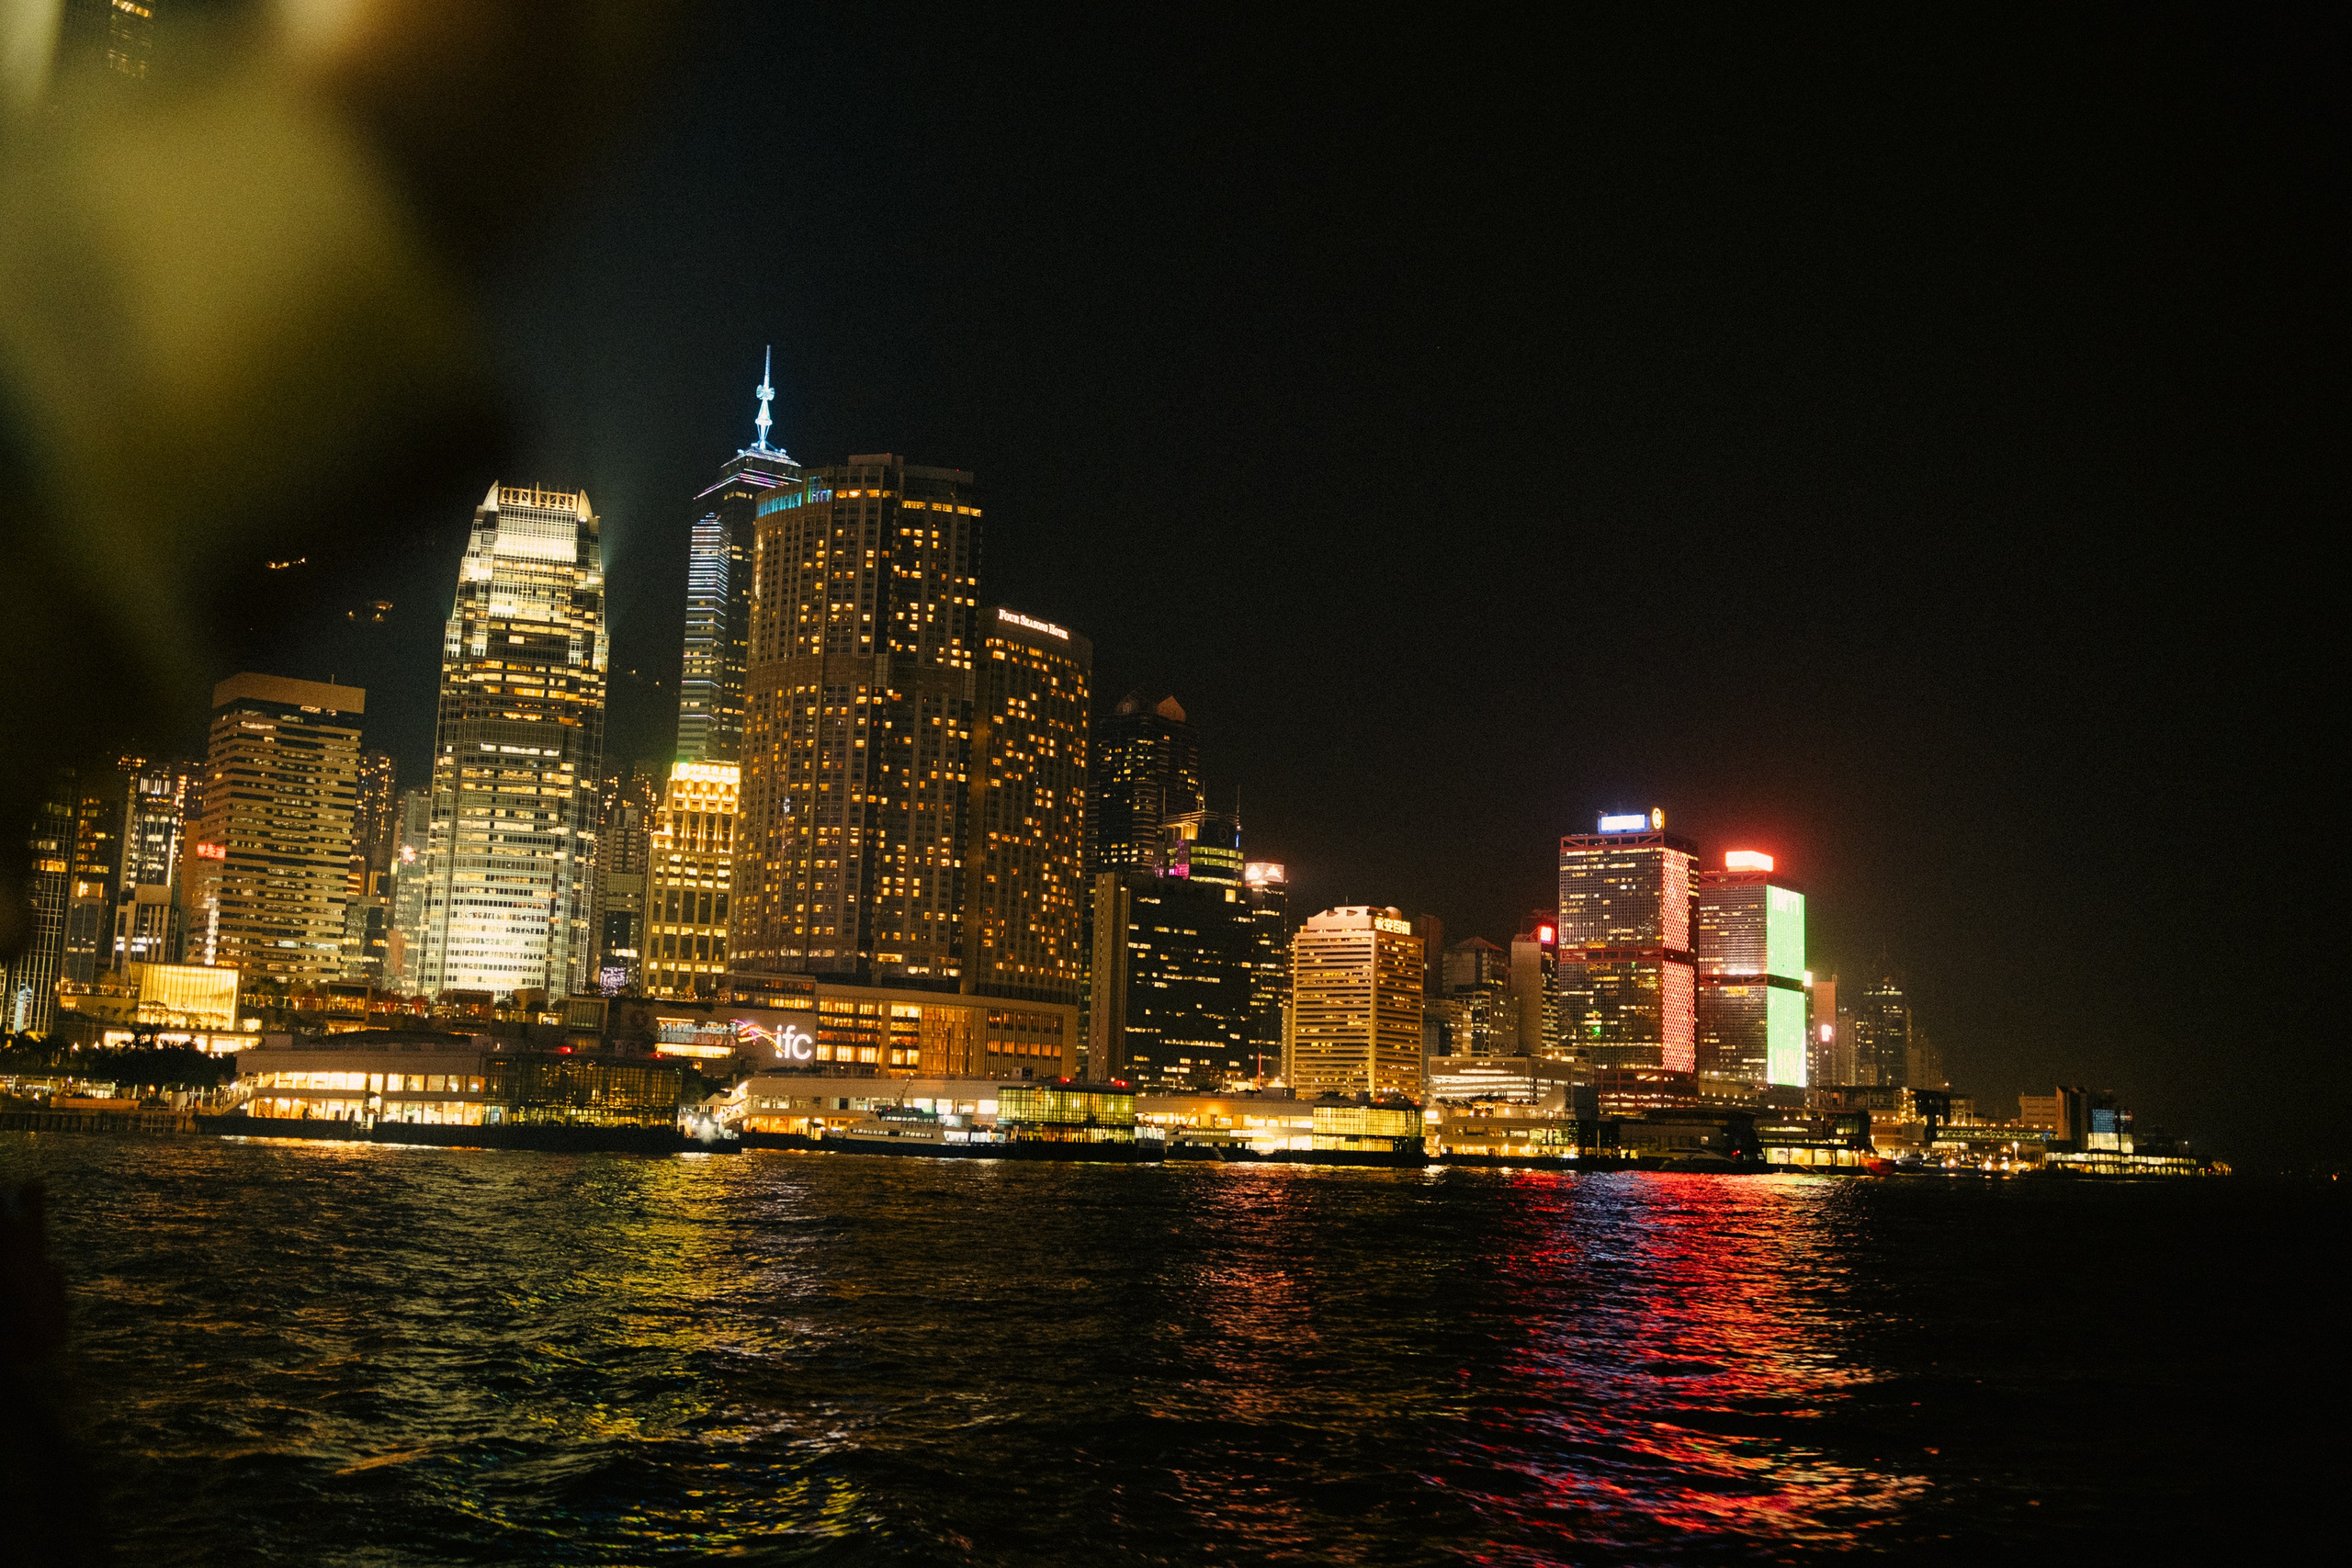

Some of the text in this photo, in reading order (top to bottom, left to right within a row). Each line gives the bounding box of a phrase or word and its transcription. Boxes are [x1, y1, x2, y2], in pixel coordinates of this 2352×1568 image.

[999, 609, 1069, 639] FOUR SEASONS HOTEL
[775, 1024, 812, 1060] ifc
